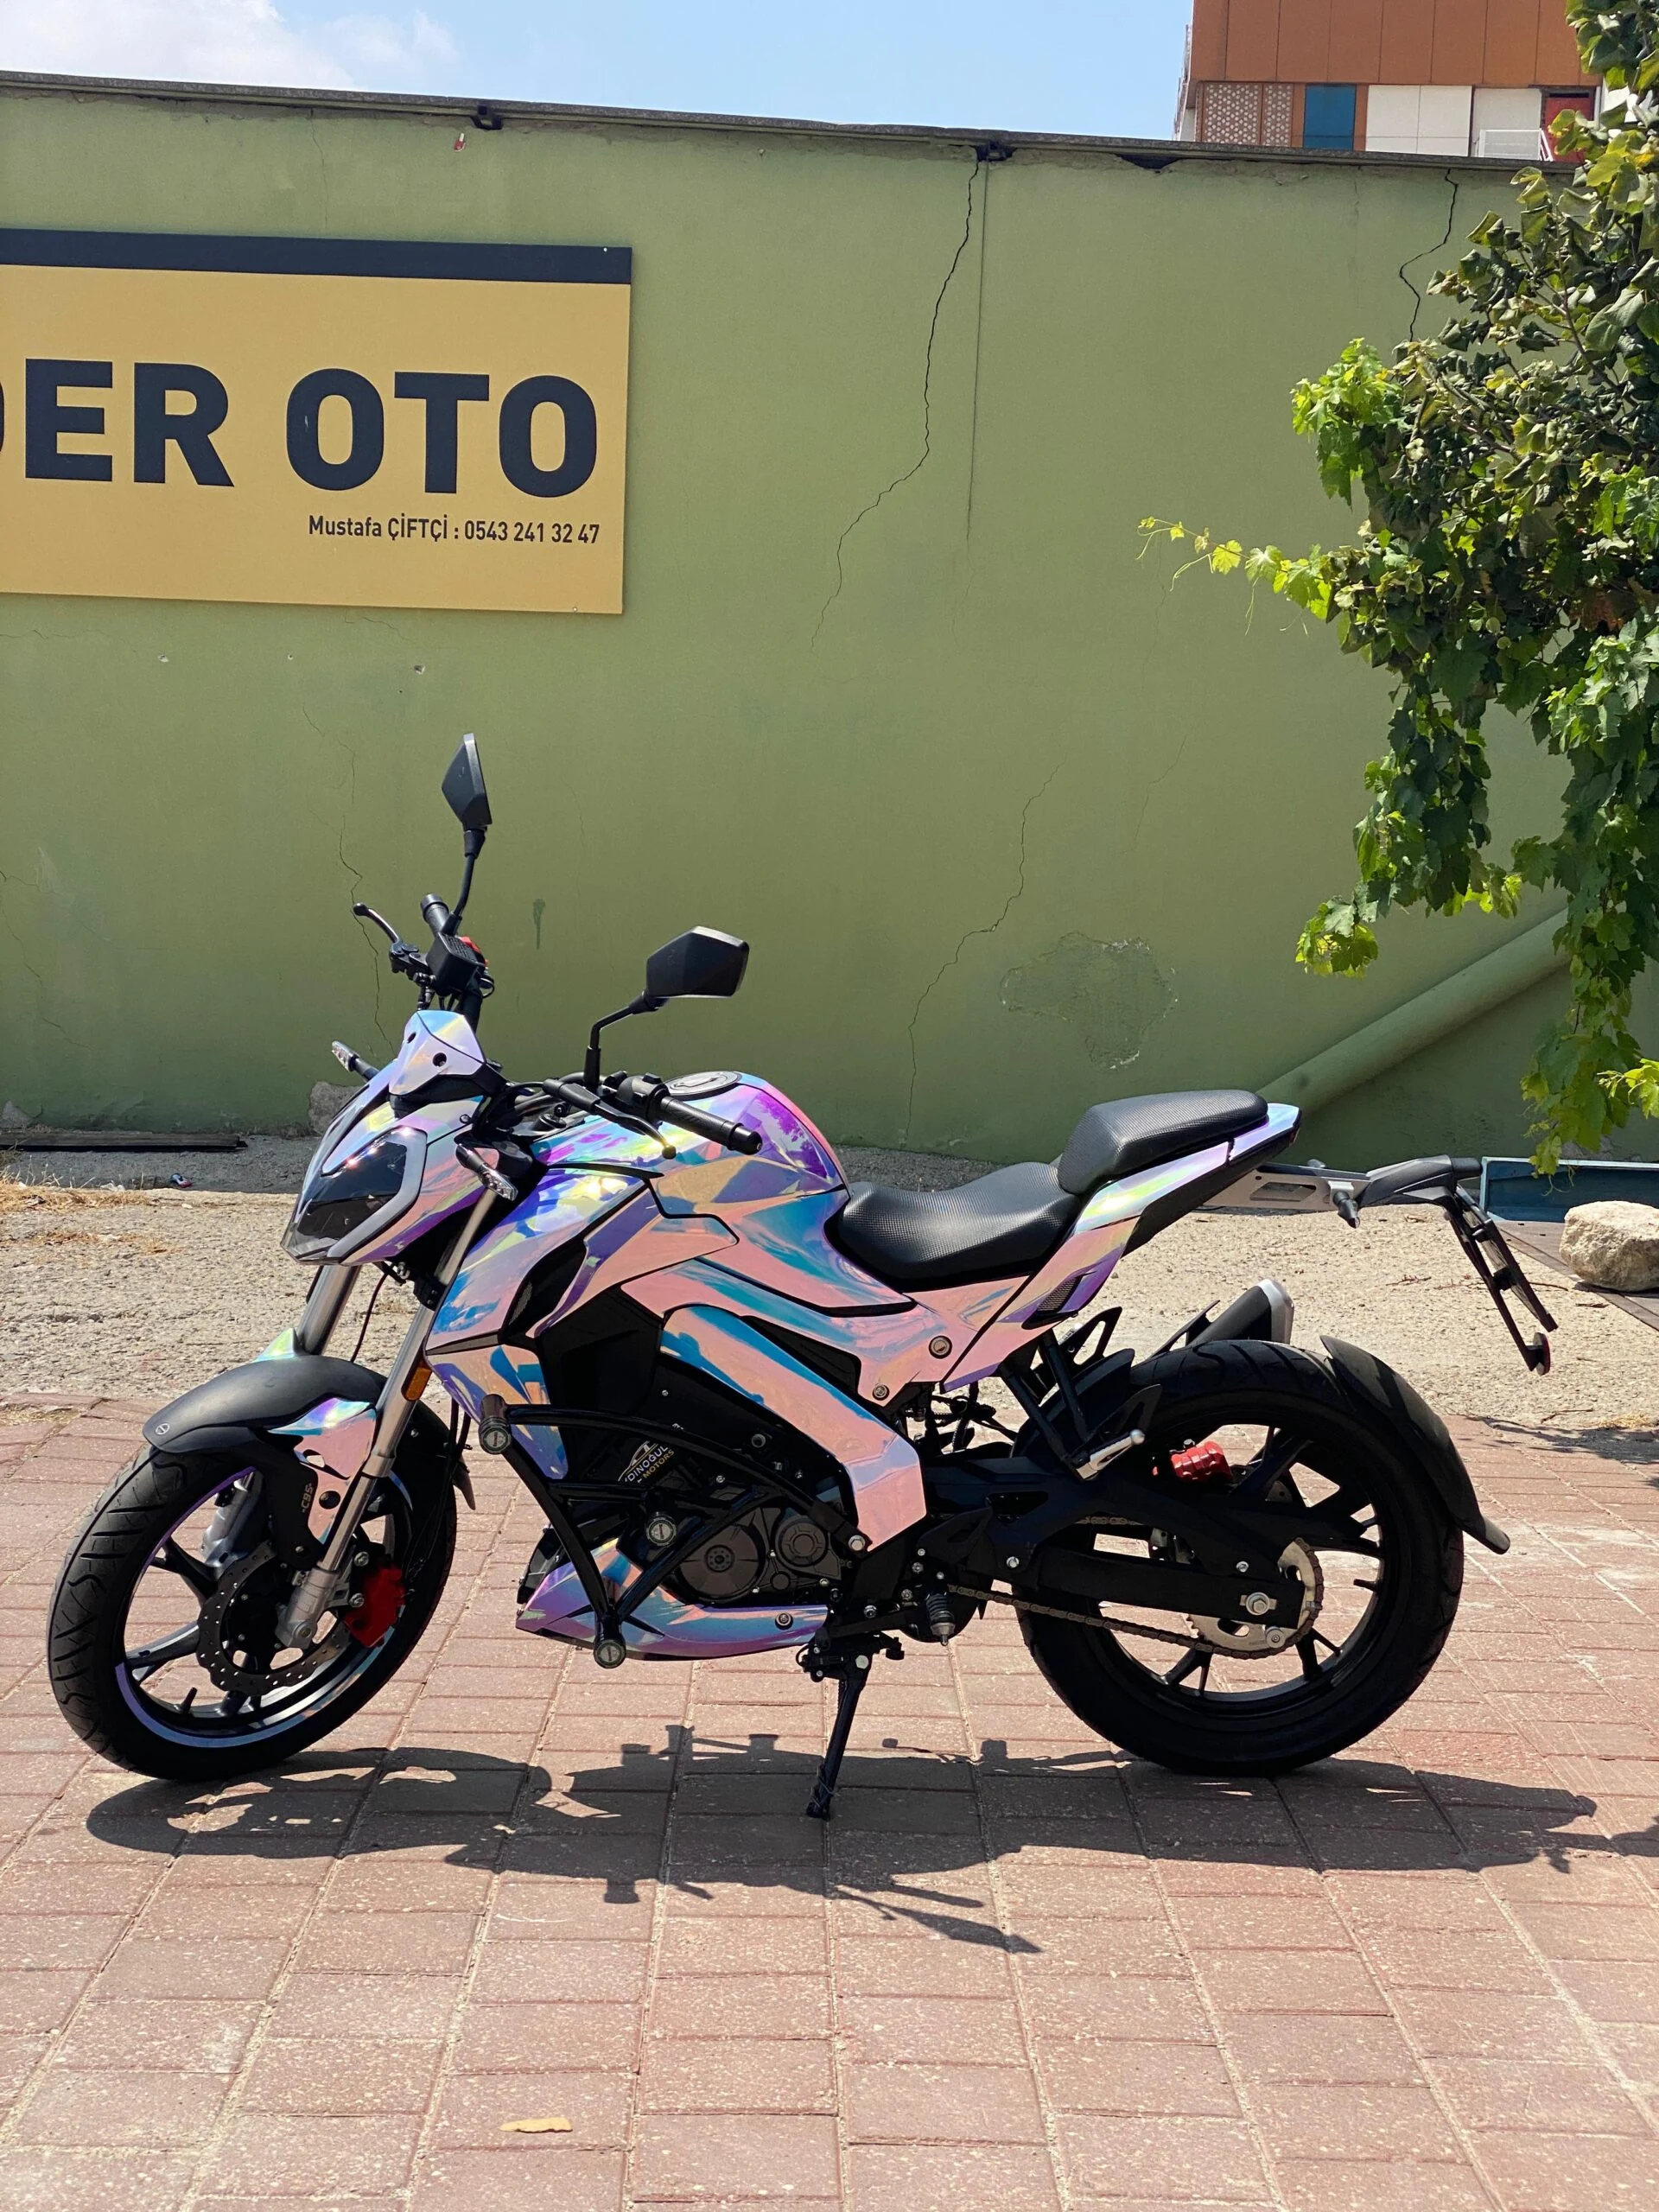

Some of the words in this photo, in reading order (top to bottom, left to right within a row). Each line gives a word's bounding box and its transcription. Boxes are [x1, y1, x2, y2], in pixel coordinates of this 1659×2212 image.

[0, 359, 234, 488] ER
[287, 369, 597, 499] OTO
[308, 515, 382, 537] Mustafa
[387, 512, 448, 543] ÇİFTÇİ
[464, 520, 508, 542] 0543
[513, 521, 544, 543] 241
[551, 523, 573, 543] 32
[577, 524, 600, 544] 47
[642, 1449, 675, 1479] MOTORS
